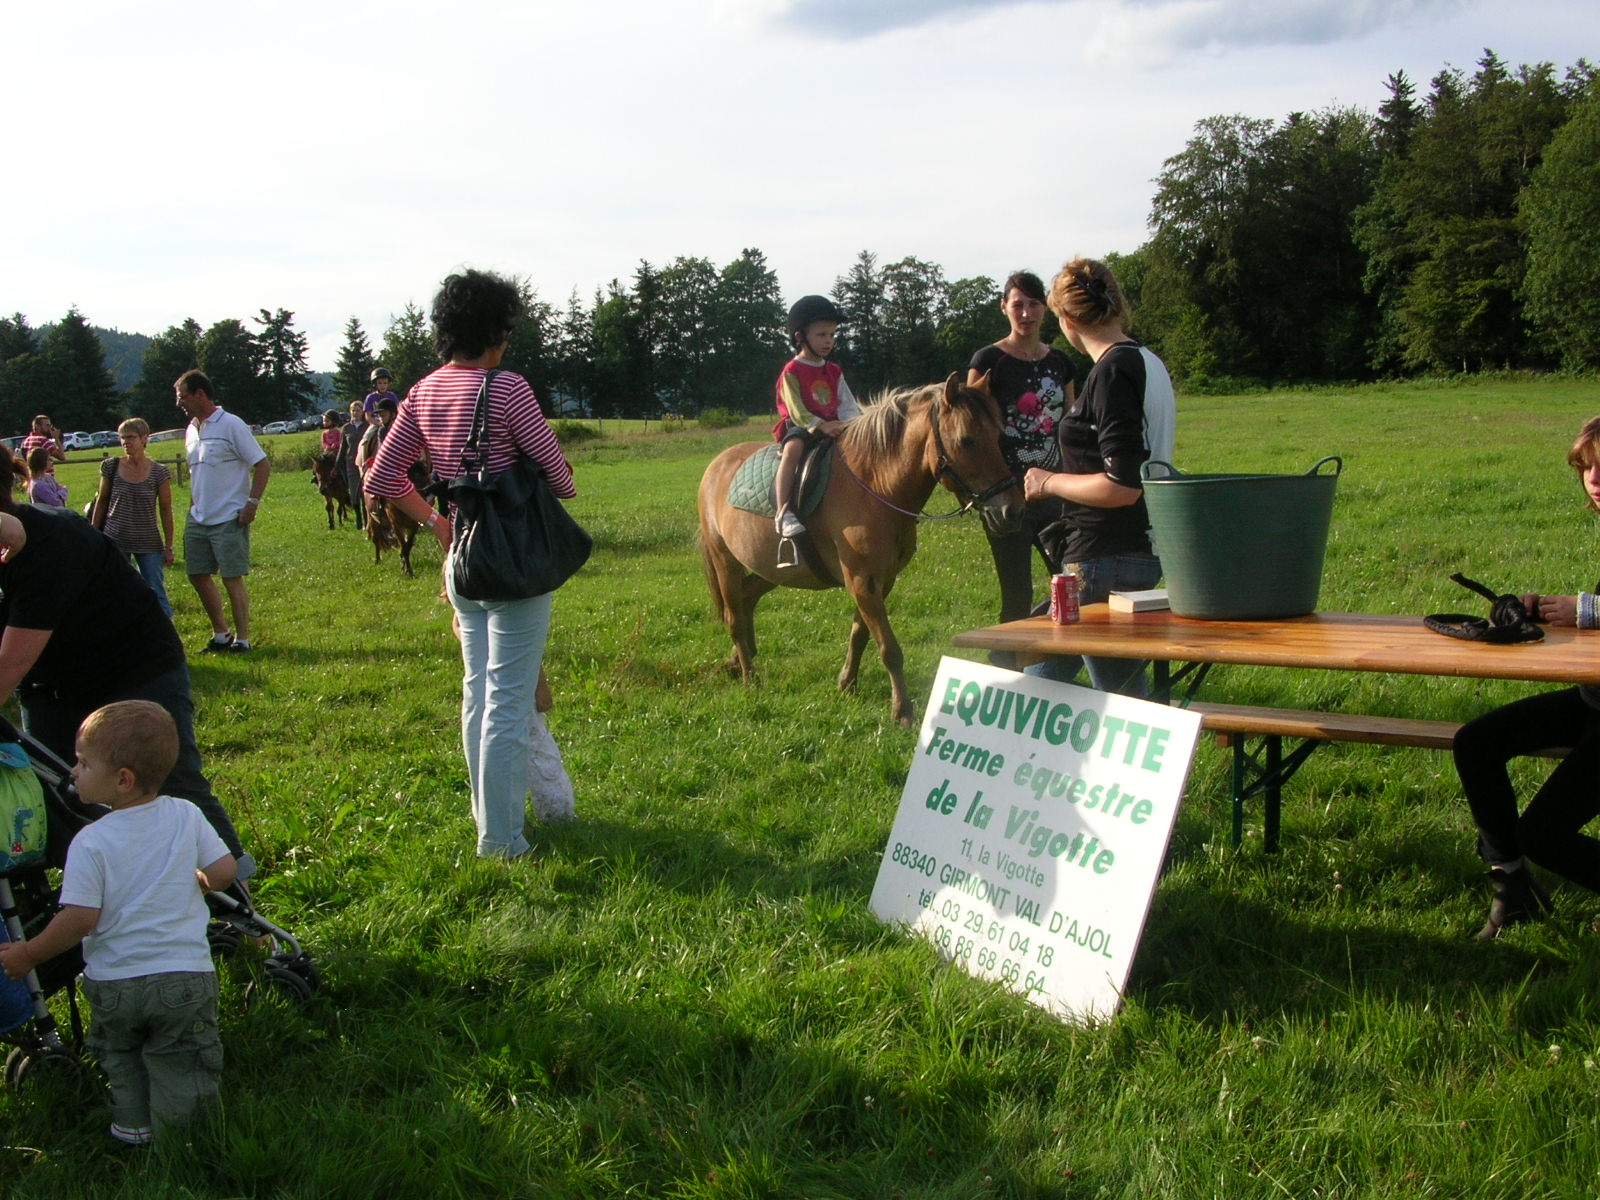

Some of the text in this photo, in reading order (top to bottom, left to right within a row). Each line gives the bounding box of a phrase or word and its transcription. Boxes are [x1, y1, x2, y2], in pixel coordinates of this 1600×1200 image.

[938, 677, 1171, 773] EQUIVIGOTTE
[925, 726, 1153, 825] Ferme équestre
[925, 779, 1115, 874] de la Vigotte
[961, 838, 1045, 888] 11, la Vigotte
[891, 842, 1113, 959] 88340 GIRMONT VAL D'AJOL
[941, 899, 960, 923] 03
[963, 910, 984, 933] 29
[987, 921, 1005, 944] 61
[1009, 931, 1030, 956] 04
[1037, 943, 1054, 968] 18
[934, 924, 1045, 996] 06 88 68 66 64
